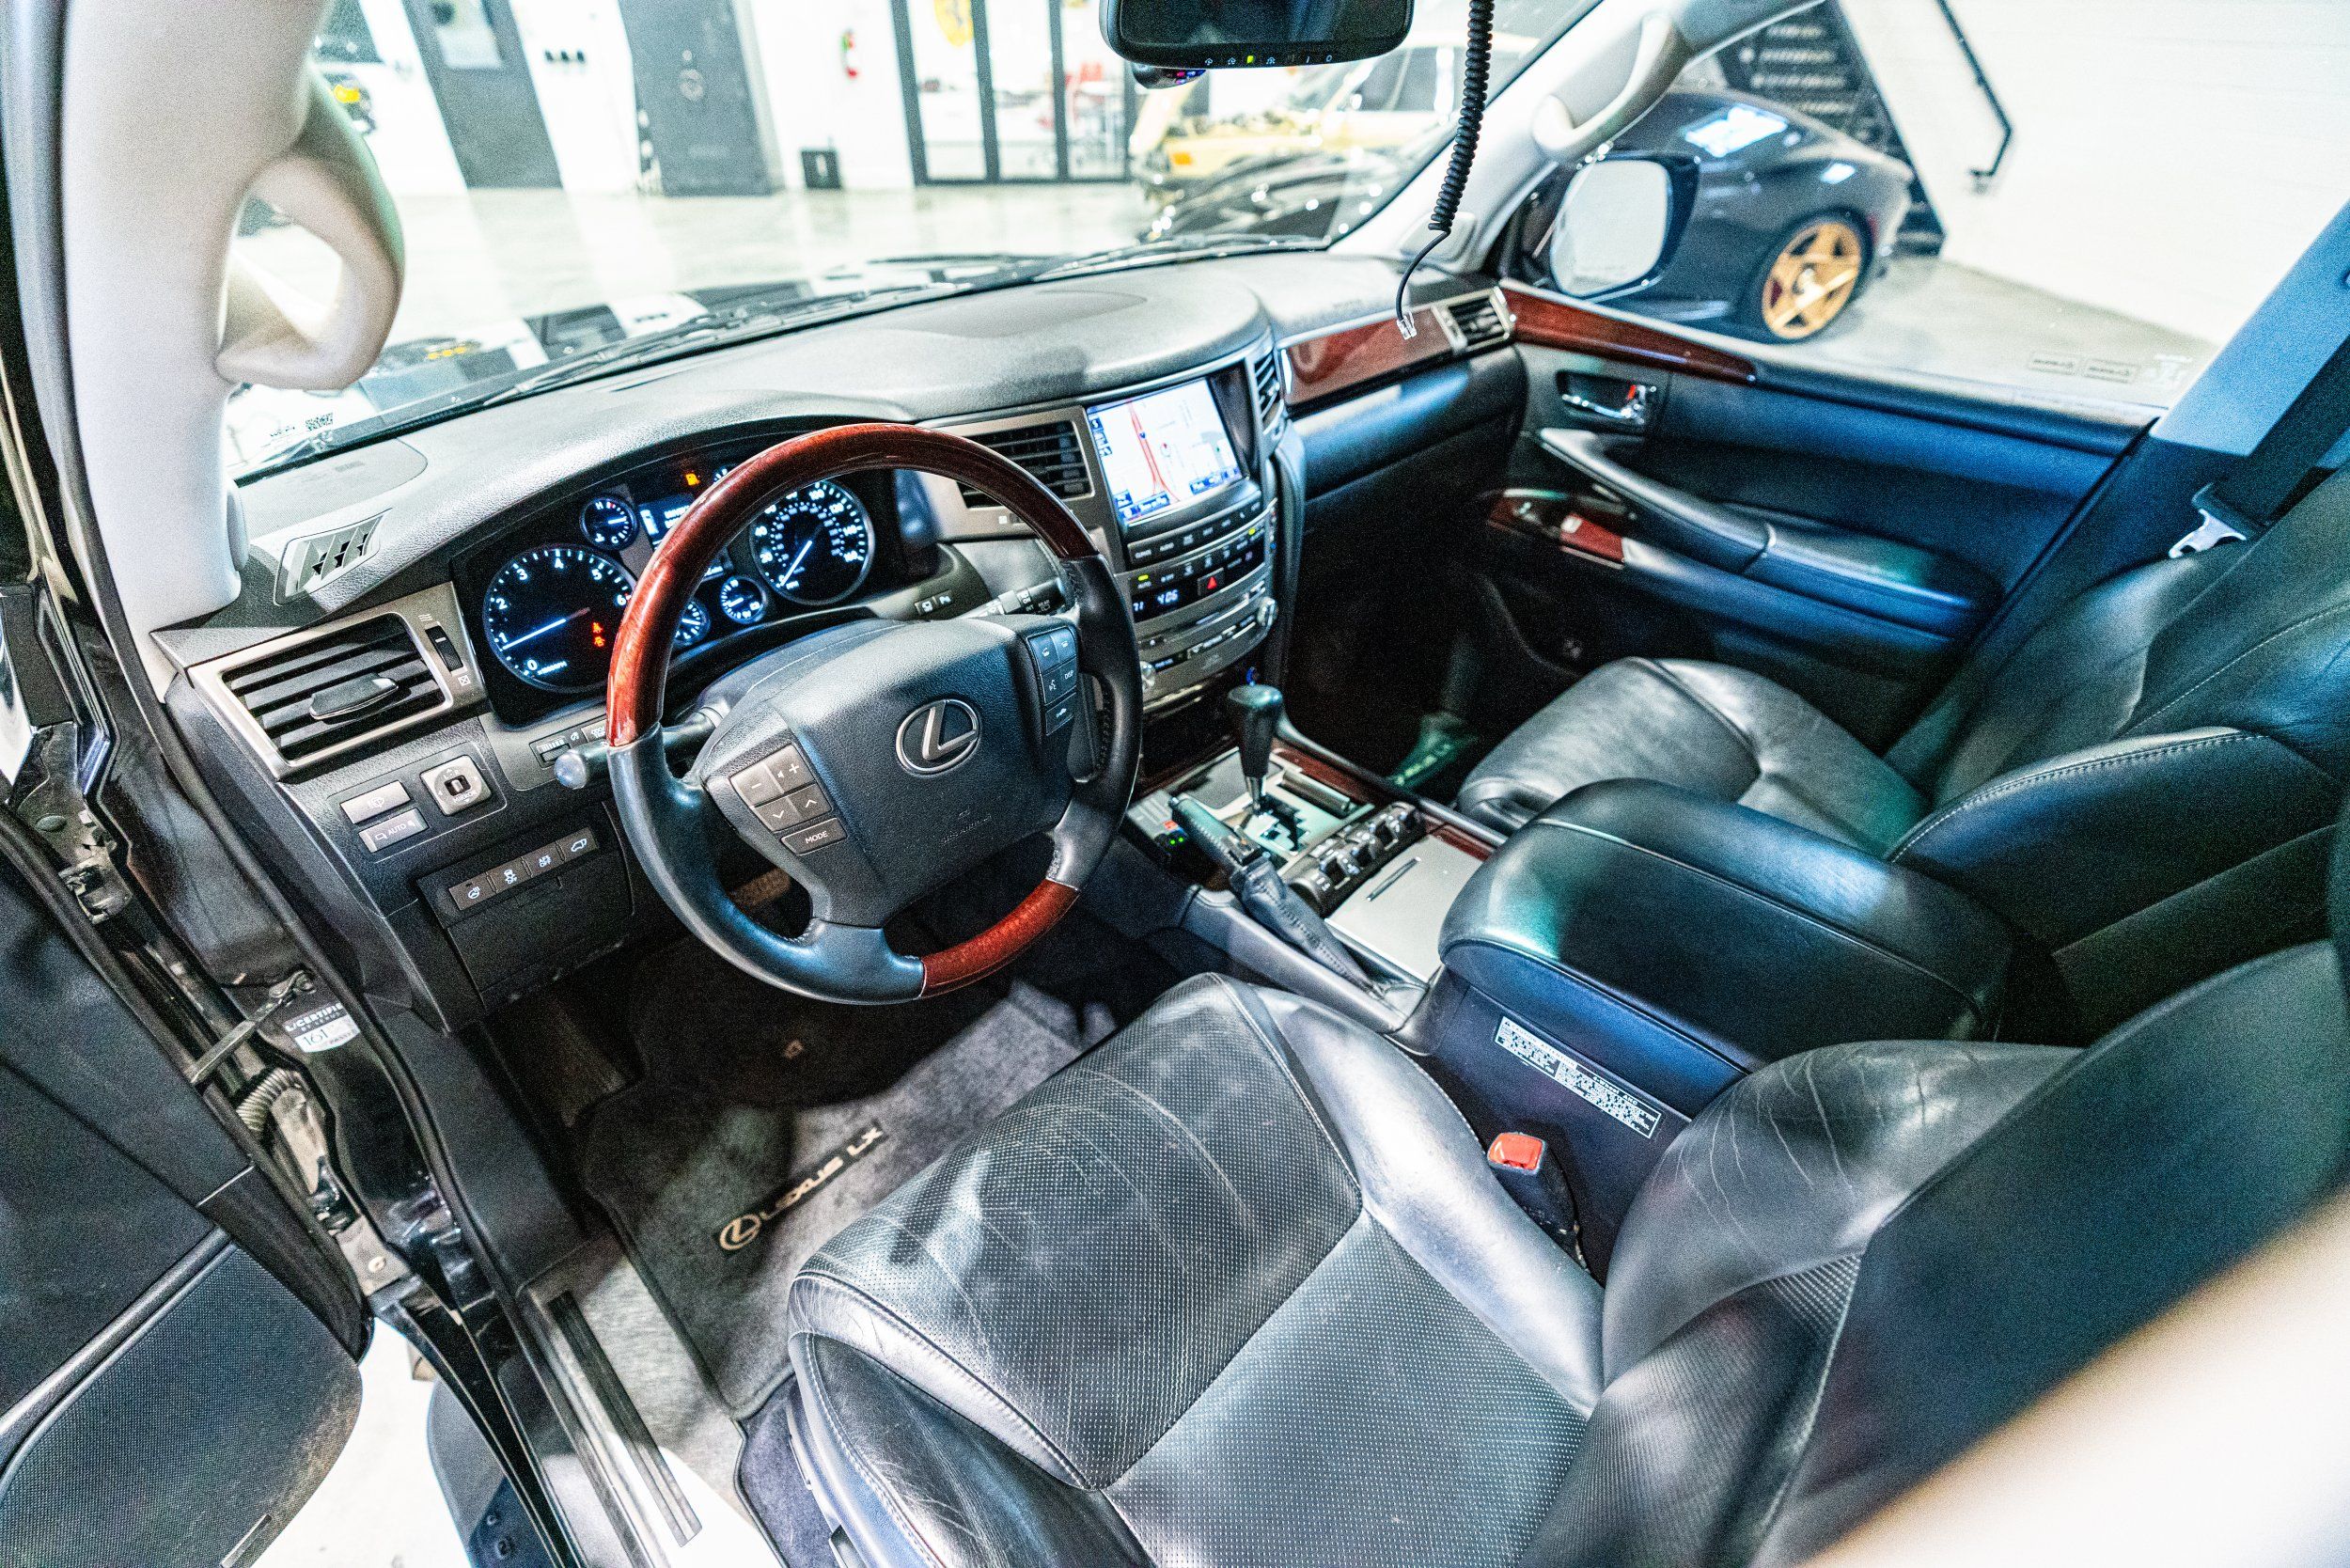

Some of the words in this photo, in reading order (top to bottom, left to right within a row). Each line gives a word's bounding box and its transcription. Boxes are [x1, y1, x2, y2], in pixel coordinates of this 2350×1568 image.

[555, 557, 564, 570] 4
[517, 568, 528, 580] 3
[591, 568, 603, 580] 5
[495, 598, 509, 610] 2
[617, 595, 627, 606] 6
[498, 632, 509, 643] 1
[526, 659, 538, 671] 0
[388, 823, 407, 836] AUTO
[805, 830, 828, 844] MODE
